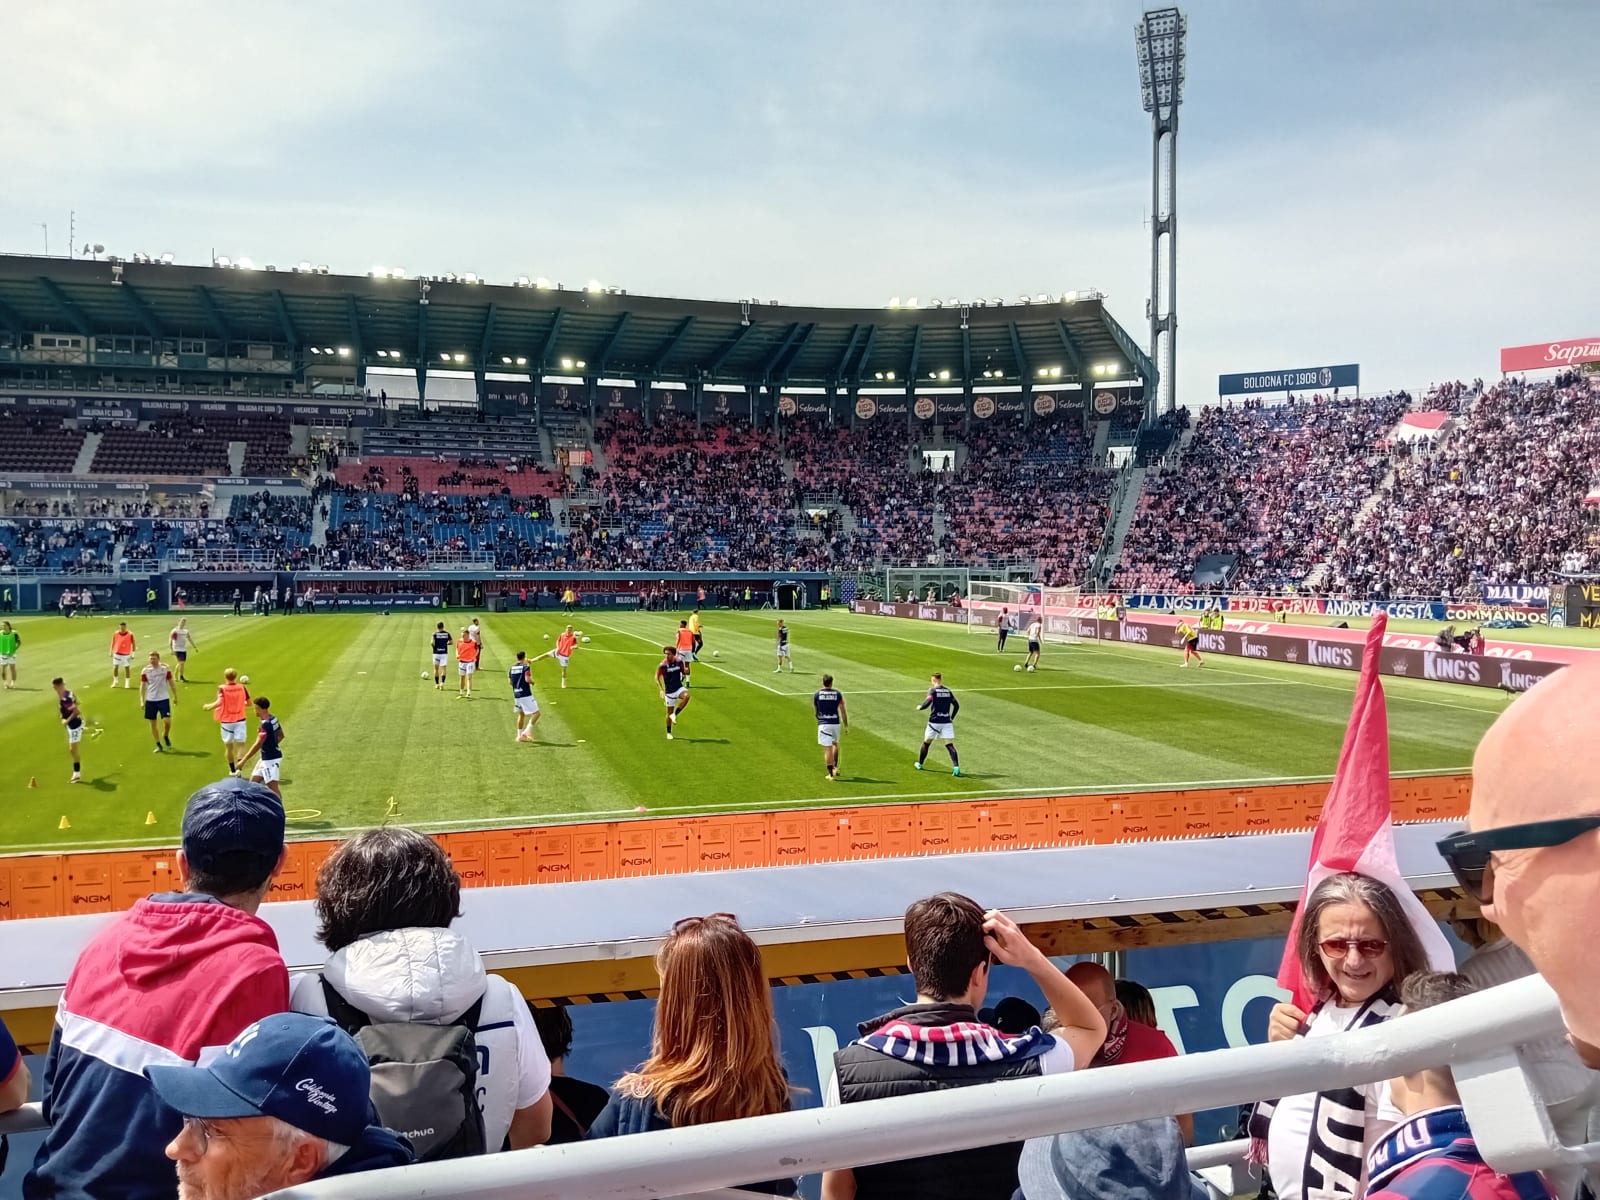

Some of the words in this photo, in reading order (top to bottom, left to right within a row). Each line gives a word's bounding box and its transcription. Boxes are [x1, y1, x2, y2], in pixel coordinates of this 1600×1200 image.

[1243, 375, 1282, 389] BOLOGNA
[1283, 374, 1294, 386] FC
[1296, 372, 1317, 384] 1909
[1138, 595, 1157, 609] LA
[1164, 596, 1223, 610] NOSTRA
[1227, 597, 1269, 613] FEDE
[1387, 602, 1434, 619] COSTA
[1446, 609, 1548, 624] COMMANDOS
[1197, 632, 1225, 651] ING'S
[1242, 636, 1268, 657] KING'S
[1307, 639, 1353, 666] KING'S
[1423, 651, 1481, 683] KING'S
[295, 1078, 336, 1101] California
[307, 1091, 338, 1114] Vintage
